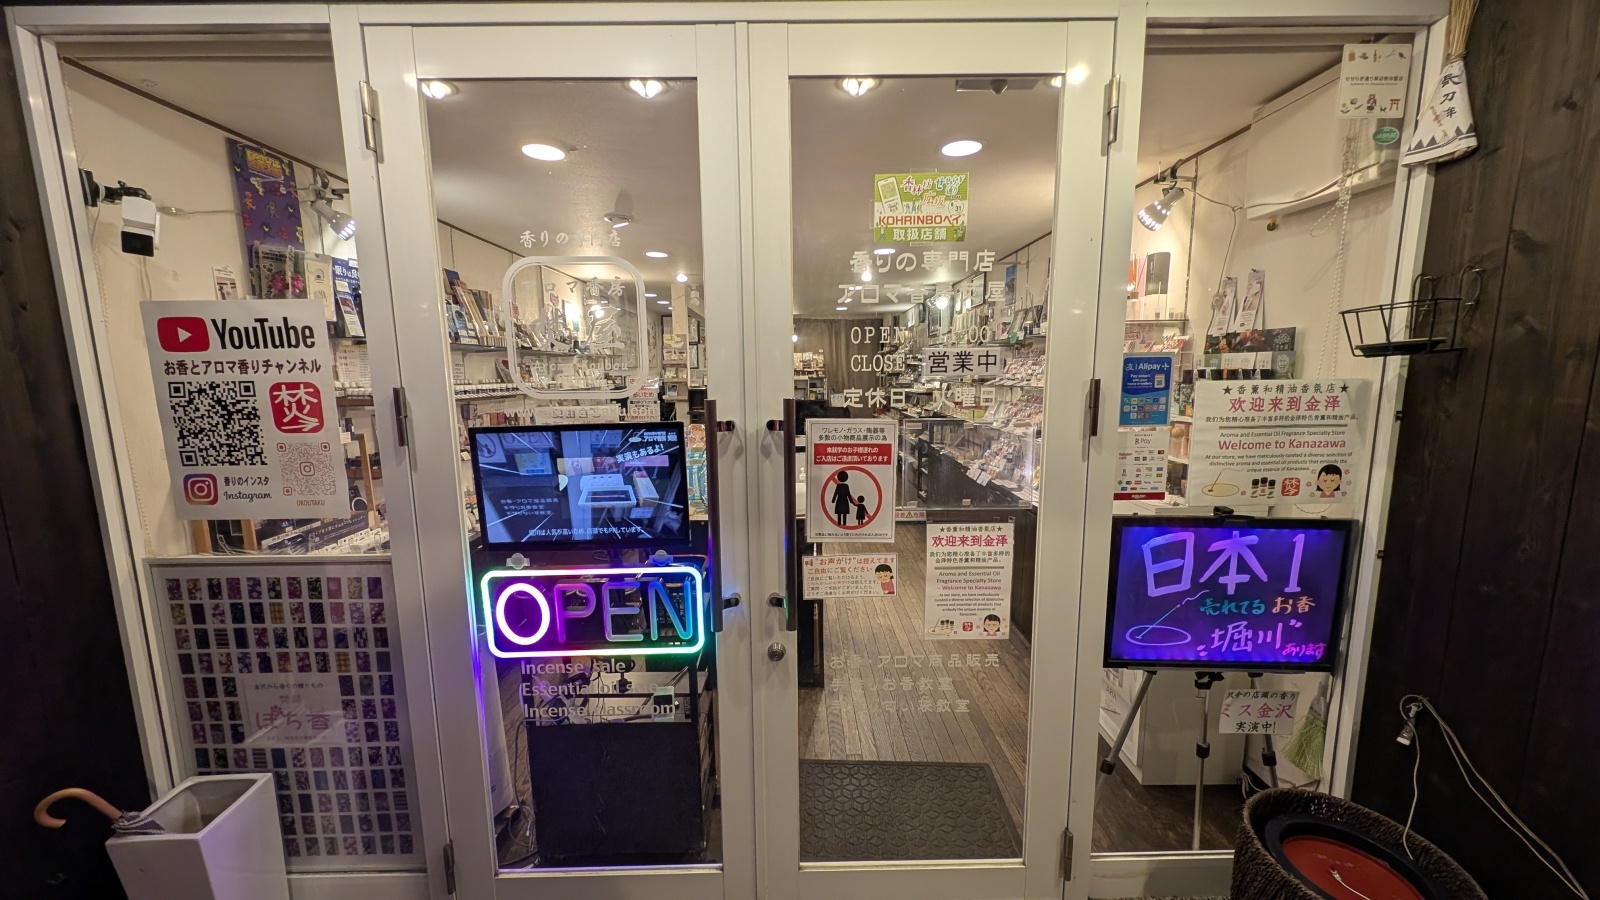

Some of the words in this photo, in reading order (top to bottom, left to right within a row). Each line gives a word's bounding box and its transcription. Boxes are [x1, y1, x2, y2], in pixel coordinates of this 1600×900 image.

[893, 228, 947, 241] 取扱店舗
[850, 249, 996, 273] 香りの専門店
[211, 316, 316, 350] YouTube
[850, 327, 907, 344] OPEN
[164, 358, 321, 376] お香とアロマ香りチャンネル
[850, 354, 906, 372] CLOSE
[928, 350, 997, 374] 営業中
[843, 387, 907, 409] 定休日
[934, 387, 997, 408] 火曜日
[1228, 395, 1341, 413] 欢迎来到金泽
[1218, 440, 1272, 450] Welcome
[1275, 440, 1285, 449] to
[1289, 438, 1346, 449] Kanazawa
[224, 476, 270, 486] 香りのインスタ
[224, 491, 272, 503] Instagram
[931, 534, 1008, 548] 欢迎来到金泽
[808, 566, 873, 574] ご自由にご覧ください
[1142, 530, 1306, 598] 日本1
[496, 580, 693, 646] OPEN
[1200, 597, 1265, 616] 売れてる
[1271, 595, 1316, 615] お香
[1210, 620, 1283, 652] 堀川
[1282, 642, 1328, 659] あります
[521, 660, 584, 674] Incense
[592, 658, 626, 673] sale
[829, 653, 1000, 669] お香・アロマ商品販売
[626, 680, 658, 694] sae
[523, 704, 587, 718] Incense
[1222, 702, 1294, 719] ミス金沢
[1235, 721, 1276, 734] 実演中!
